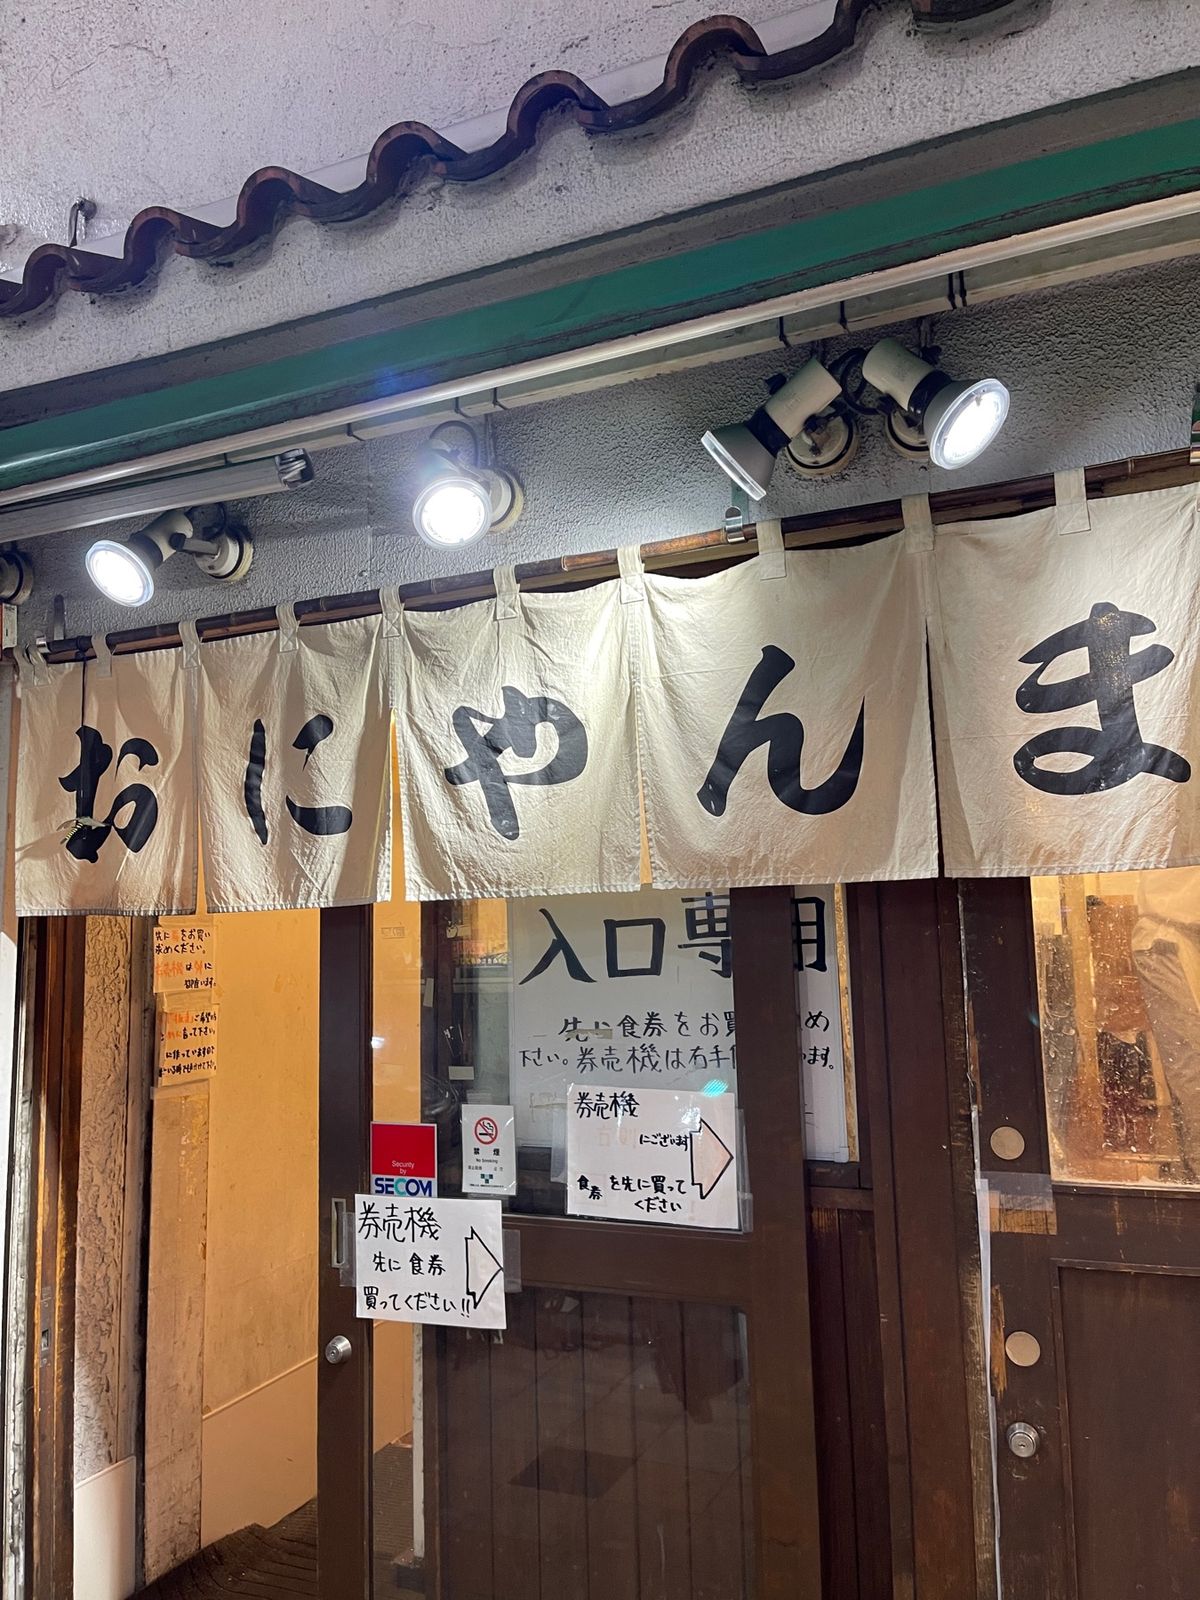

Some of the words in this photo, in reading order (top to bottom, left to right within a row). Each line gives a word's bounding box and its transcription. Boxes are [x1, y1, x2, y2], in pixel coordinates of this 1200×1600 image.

[58, 602, 1192, 863] おにやんま
[518, 891, 827, 985] 入口専用
[574, 1091, 640, 1120] 券売機
[639, 1132, 690, 1152] にございます
[391, 1160, 415, 1169] Security
[375, 1177, 433, 1197] SECOM
[577, 1175, 602, 1200] 食券
[609, 1174, 687, 1194] を先に買って
[634, 1197, 682, 1213] ください
[358, 1201, 442, 1243] 券売機
[372, 1251, 402, 1273] 先に
[409, 1252, 446, 1276] 食券
